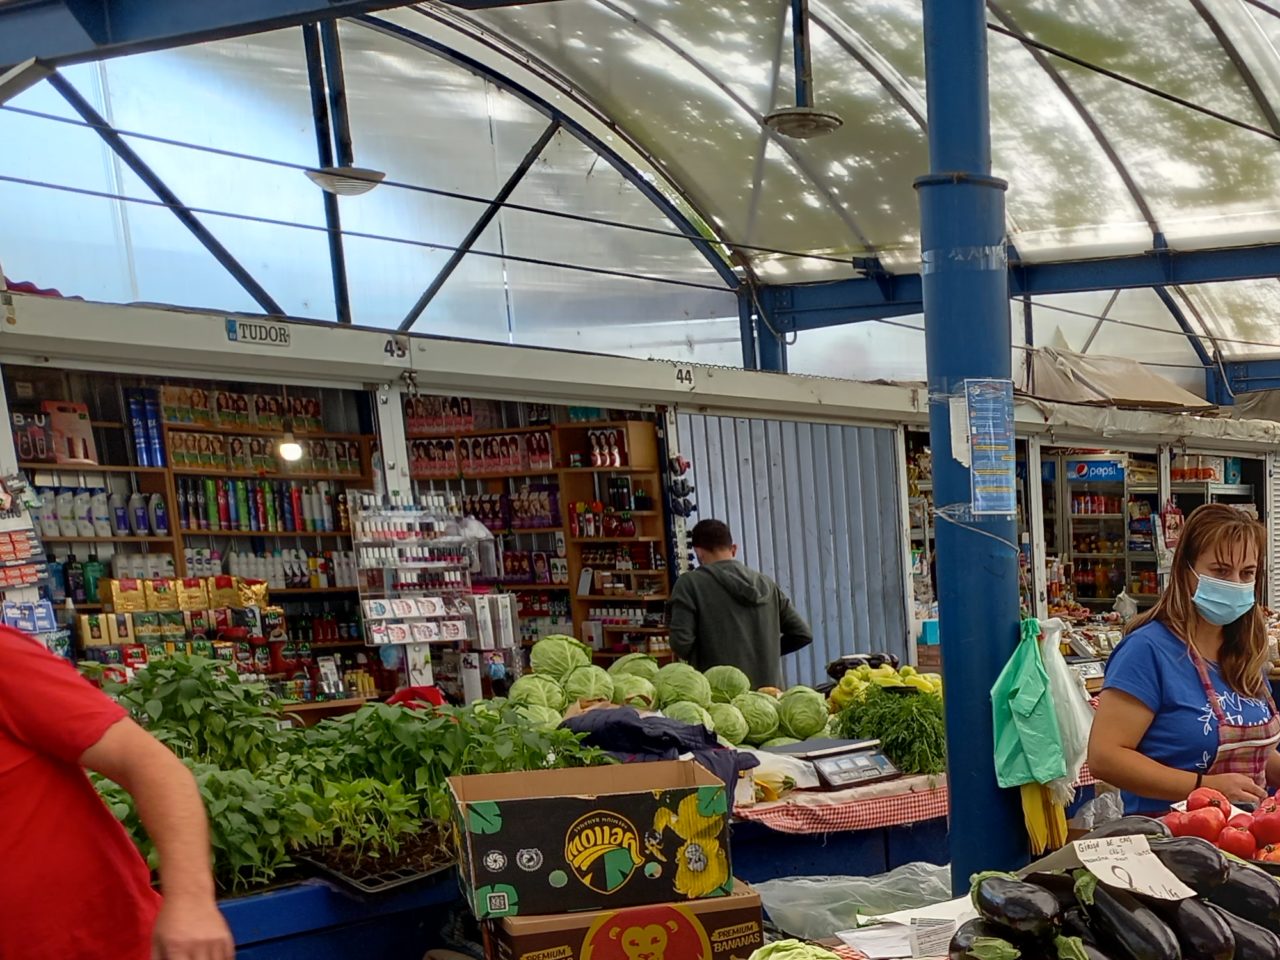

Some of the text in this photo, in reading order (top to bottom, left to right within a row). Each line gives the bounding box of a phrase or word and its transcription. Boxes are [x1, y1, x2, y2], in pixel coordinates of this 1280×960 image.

[238, 323, 289, 343] TUDOR
[676, 369, 693, 384] 44
[1089, 466, 1116, 477] pepsi
[718, 924, 754, 938] PREMIUM
[712, 932, 760, 953] BANANAS
